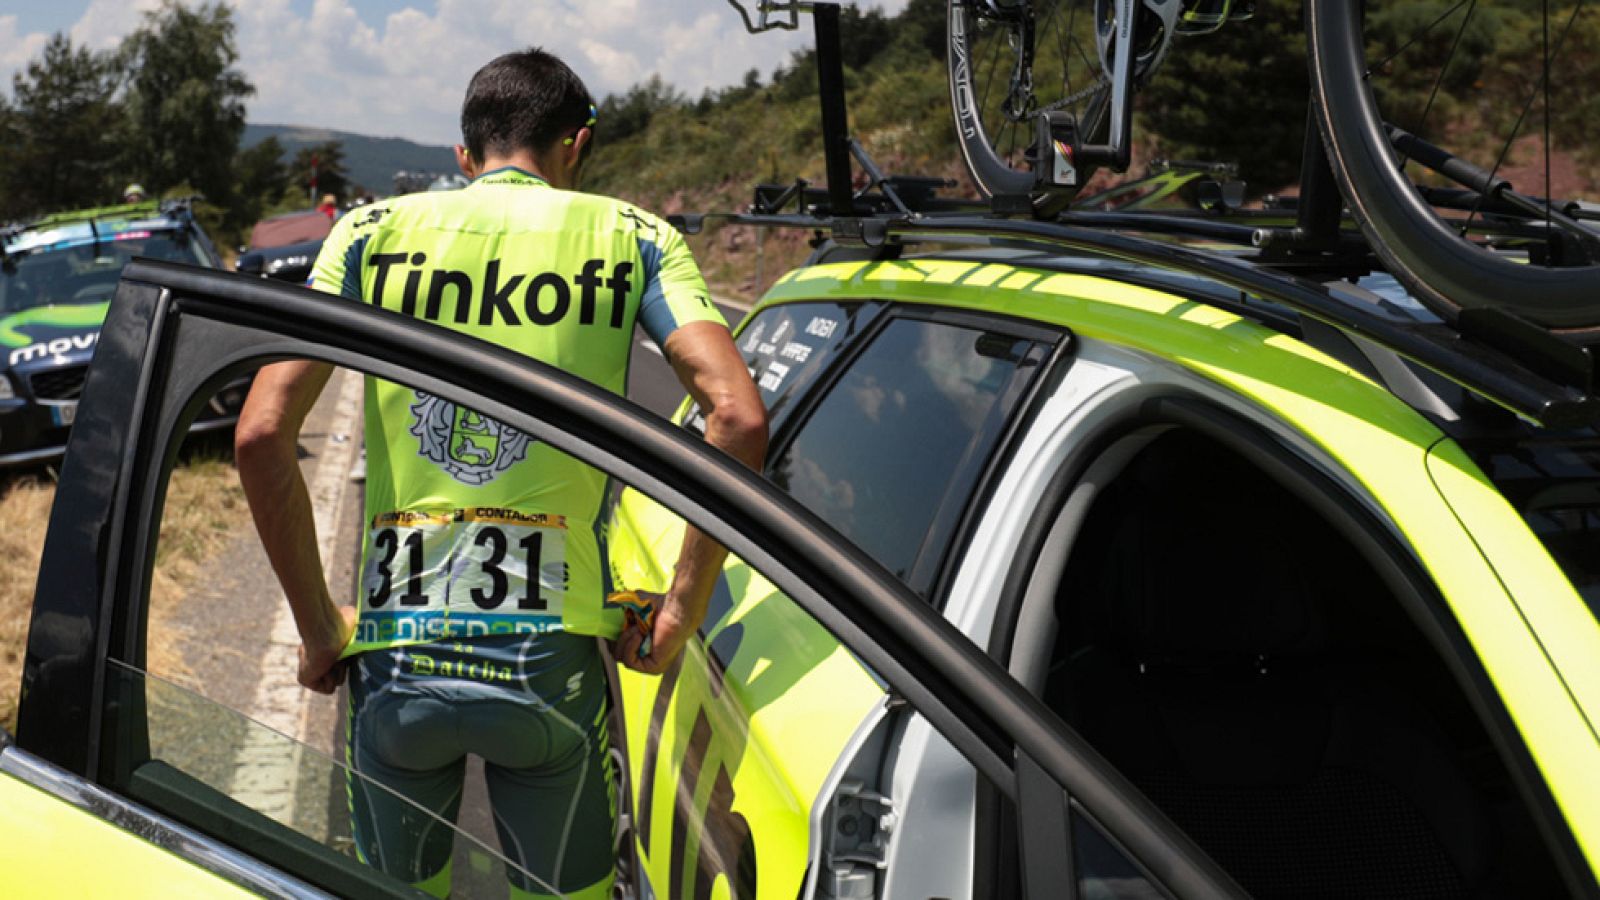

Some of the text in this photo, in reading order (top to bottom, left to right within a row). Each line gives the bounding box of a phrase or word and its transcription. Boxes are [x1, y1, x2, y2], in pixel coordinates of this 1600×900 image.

[368, 251, 634, 329] Tinkoff
[368, 527, 429, 609] 31
[470, 526, 548, 610] 31
